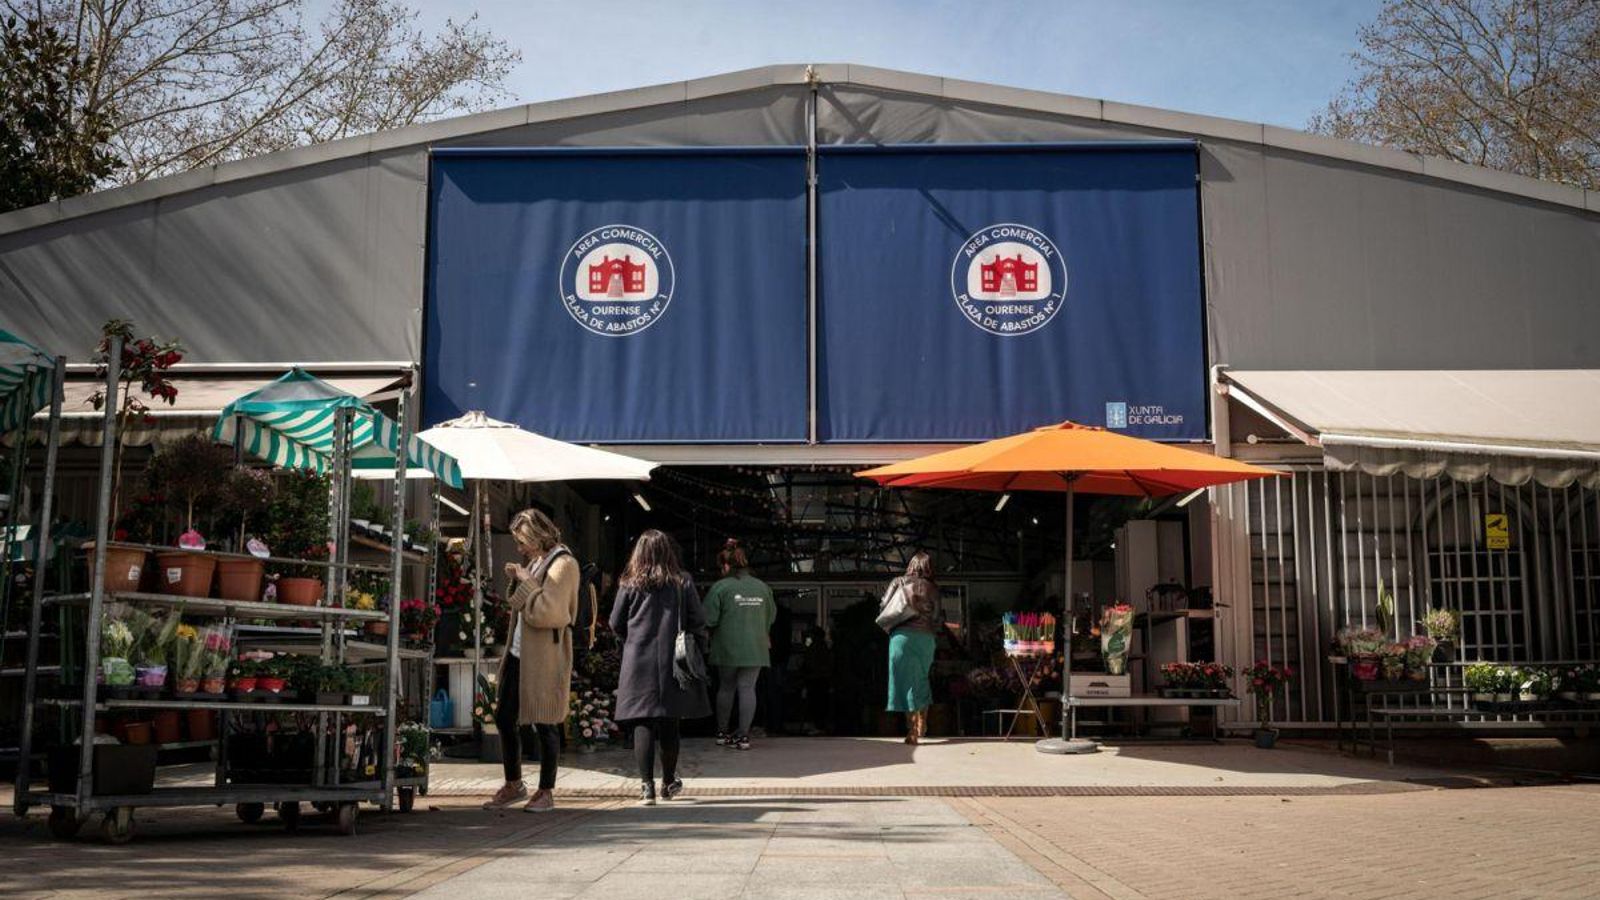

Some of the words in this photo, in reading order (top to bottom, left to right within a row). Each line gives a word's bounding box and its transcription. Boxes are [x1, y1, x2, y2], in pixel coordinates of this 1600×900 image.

[601, 229, 662, 259] COMERCIAL
[991, 228, 1054, 258] COMERCIAL
[566, 293, 589, 322] PLAZA
[589, 317, 604, 330] DE
[605, 312, 652, 332] ABASTOS
[591, 305, 641, 316] OURENSE
[958, 293, 982, 322] PLAZA
[983, 317, 999, 330] DE
[1000, 311, 1046, 332] ABASTOS
[985, 305, 1034, 315] OURENSE
[1128, 405, 1164, 415] XUNTA
[1128, 415, 1142, 425] DE
[1143, 415, 1184, 425] GALICIA
